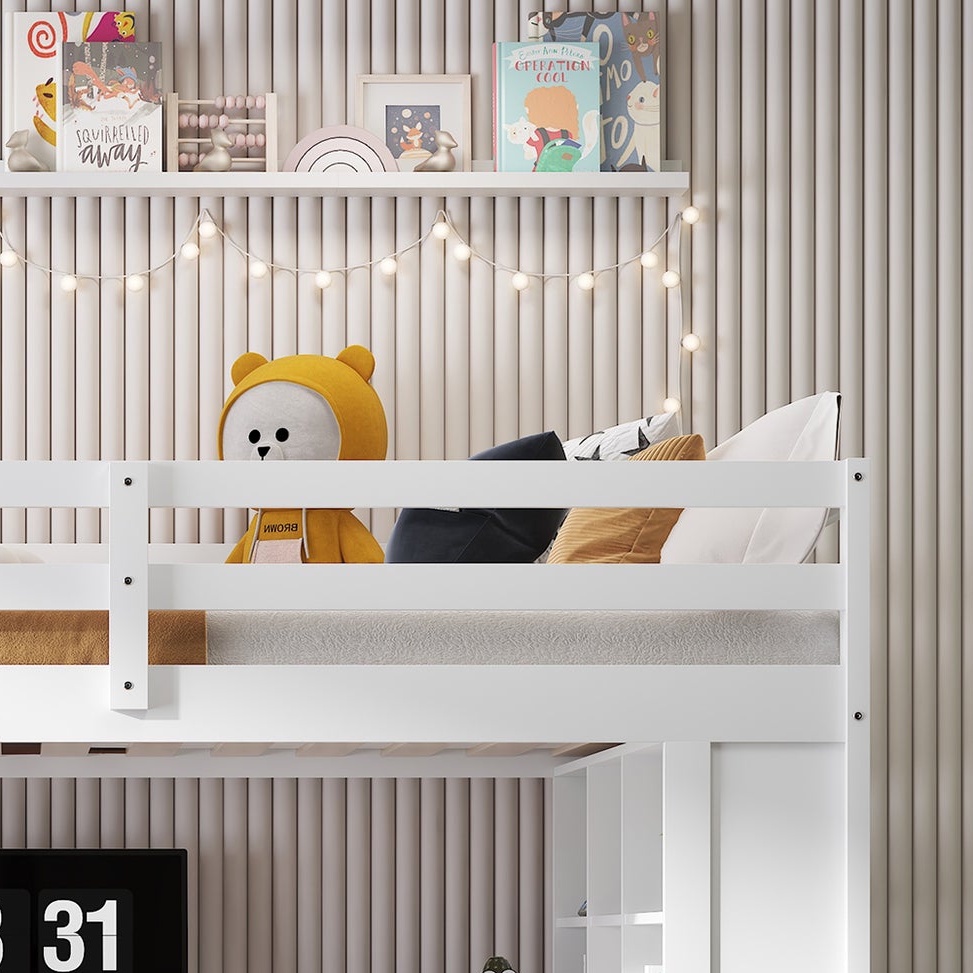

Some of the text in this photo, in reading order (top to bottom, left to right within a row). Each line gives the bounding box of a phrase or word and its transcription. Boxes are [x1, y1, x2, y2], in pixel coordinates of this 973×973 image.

[514, 60, 590, 72] OPERATION
[536, 72, 568, 83] COOL
[76, 124, 149, 148] SQUIRRELLED
[78, 143, 148, 172] away
[43, 899, 117, 973] 31
